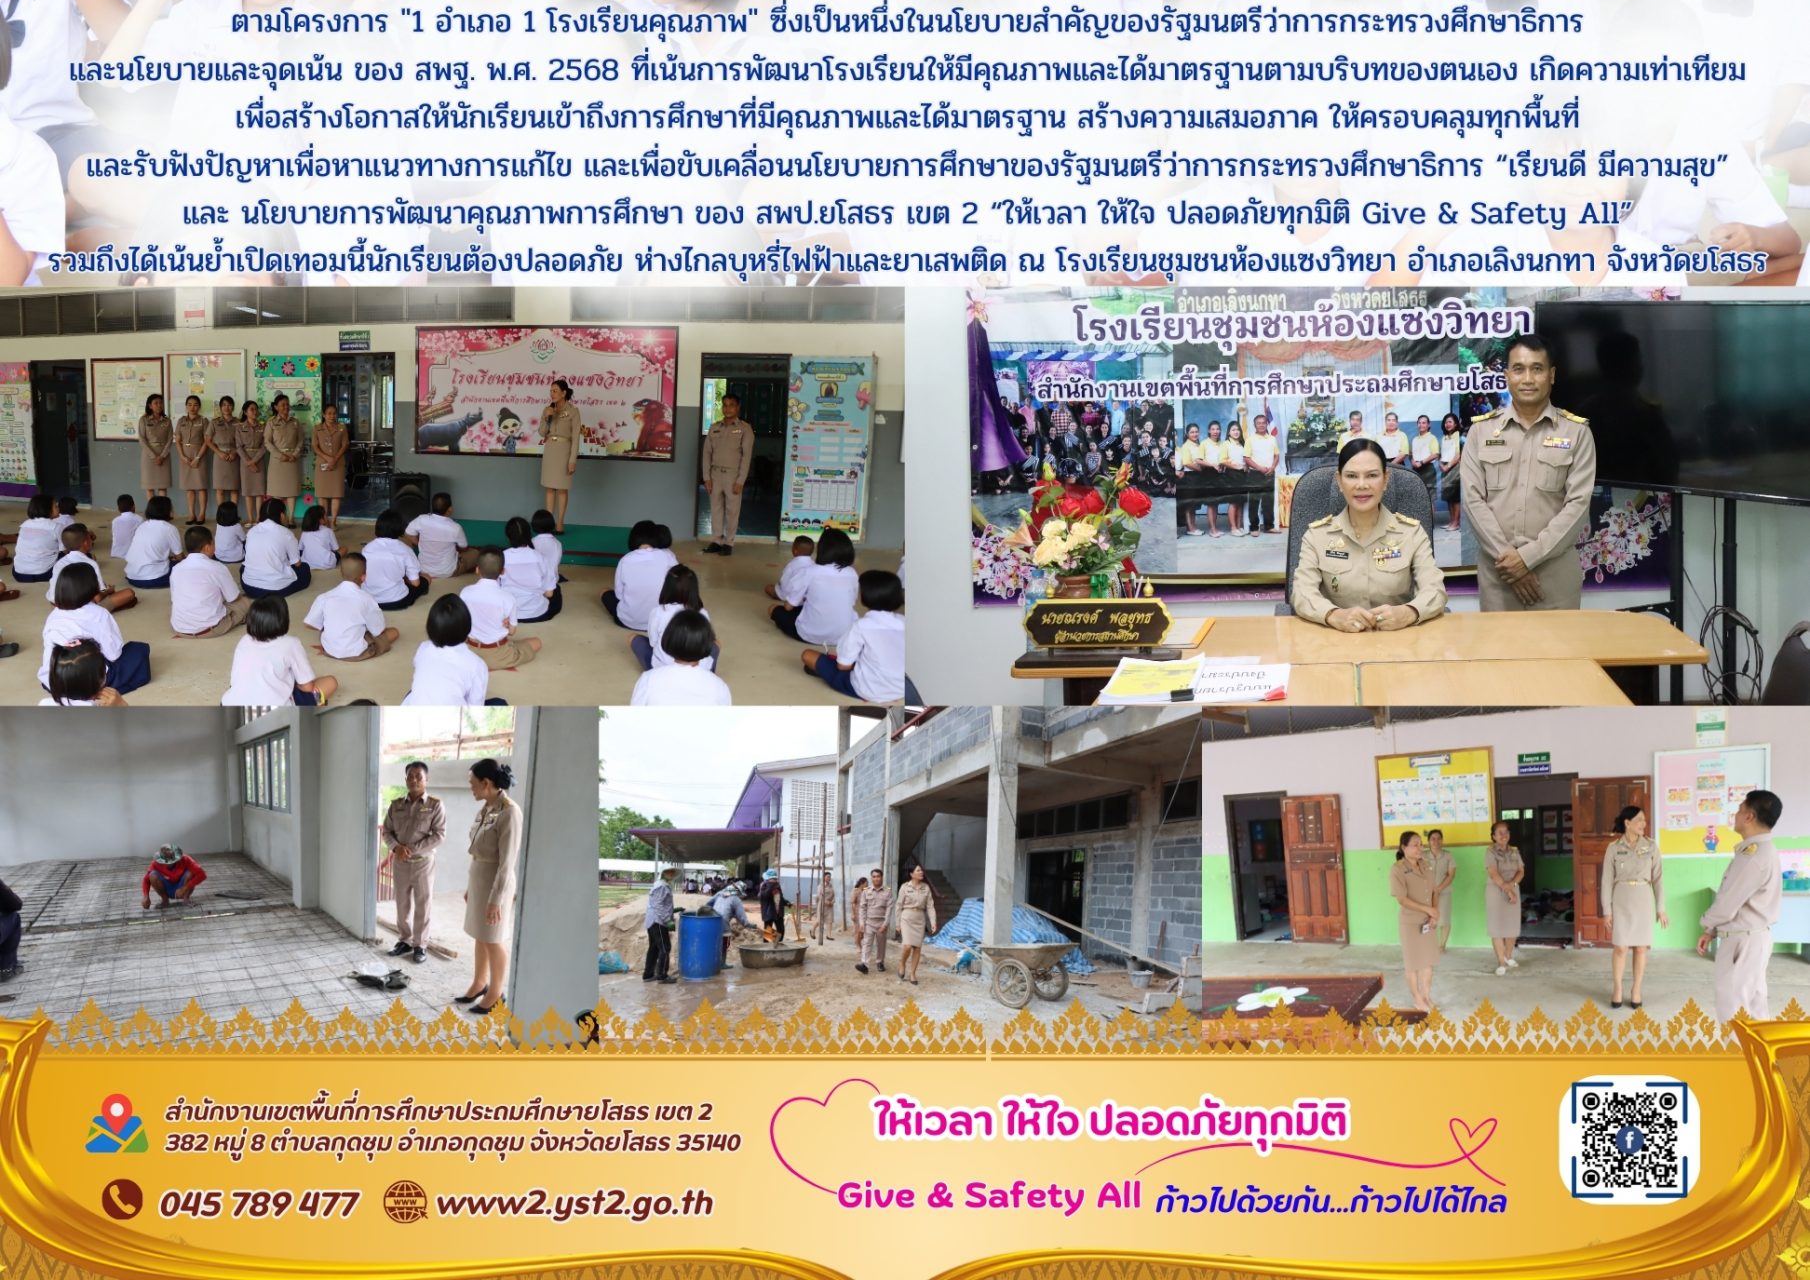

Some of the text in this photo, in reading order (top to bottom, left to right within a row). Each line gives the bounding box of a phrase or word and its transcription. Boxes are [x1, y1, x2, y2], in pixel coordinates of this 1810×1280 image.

[1073, 299, 1532, 352] โรงเรียนชุมชนห้องแซงวิทยา
[1037, 366, 1507, 399] สำนักงานเขตพื้นที่การศึกษาประถมศึกษายโสธ
[1042, 608, 1104, 625] นายณรงค์
